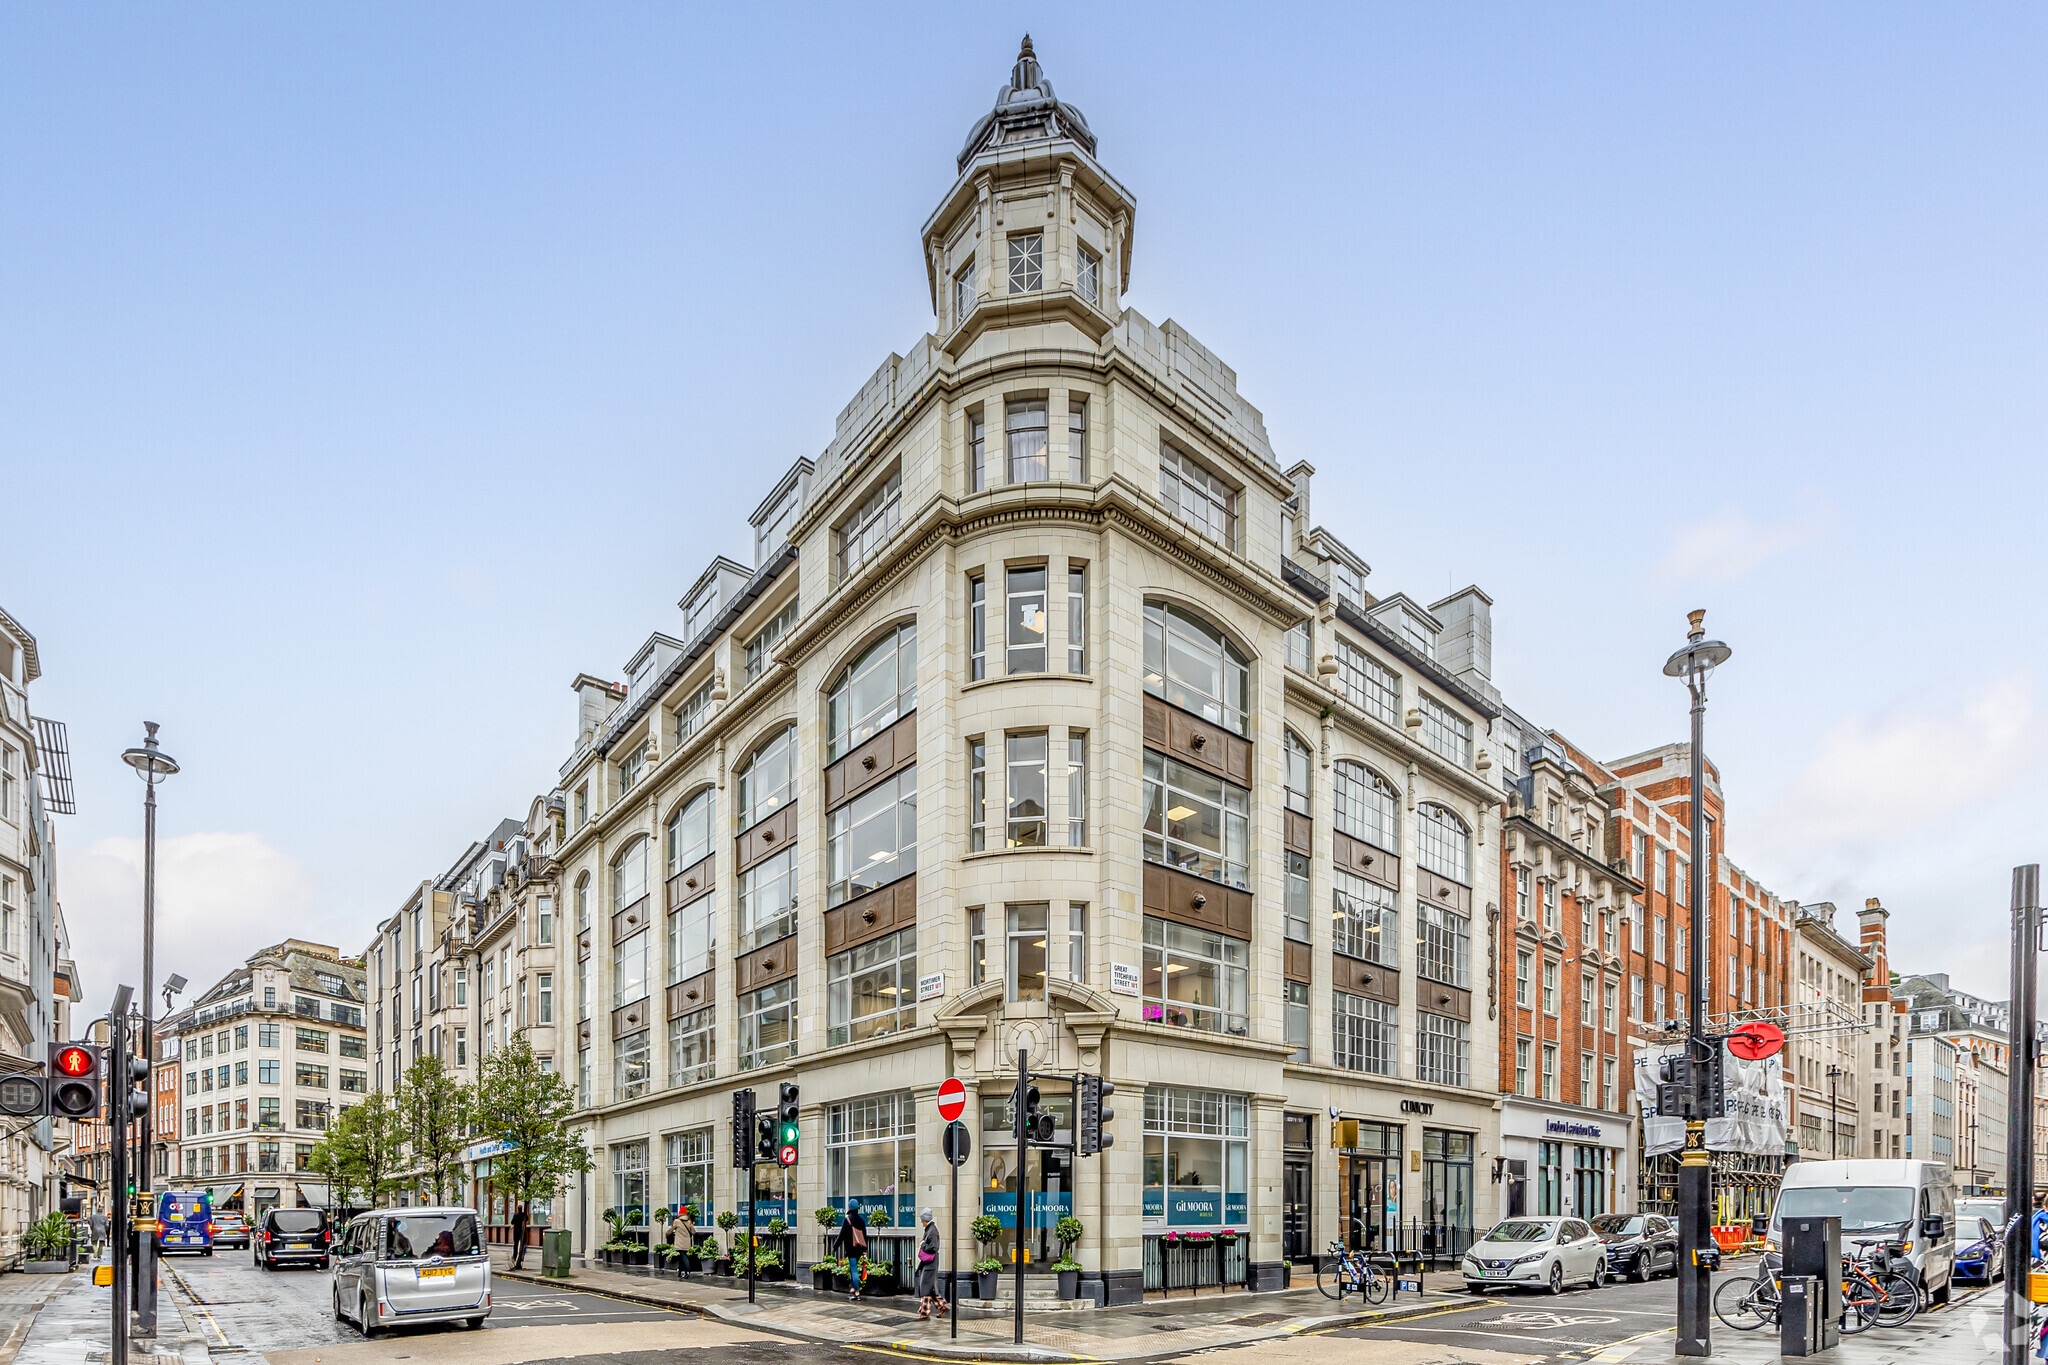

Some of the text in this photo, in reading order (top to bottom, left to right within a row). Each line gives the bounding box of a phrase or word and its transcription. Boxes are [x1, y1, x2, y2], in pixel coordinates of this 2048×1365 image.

[1114, 964, 1127, 973] GREAT
[920, 975, 941, 987] MORTIMER
[1114, 972, 1138, 982] TITCHFIELD
[1114, 979, 1130, 988] STREET
[920, 984, 934, 994] STREET
[1634, 1057, 1648, 1067] PE
[1641, 1106, 1657, 1119] GP
[858, 1203, 888, 1214] iLMOORA
